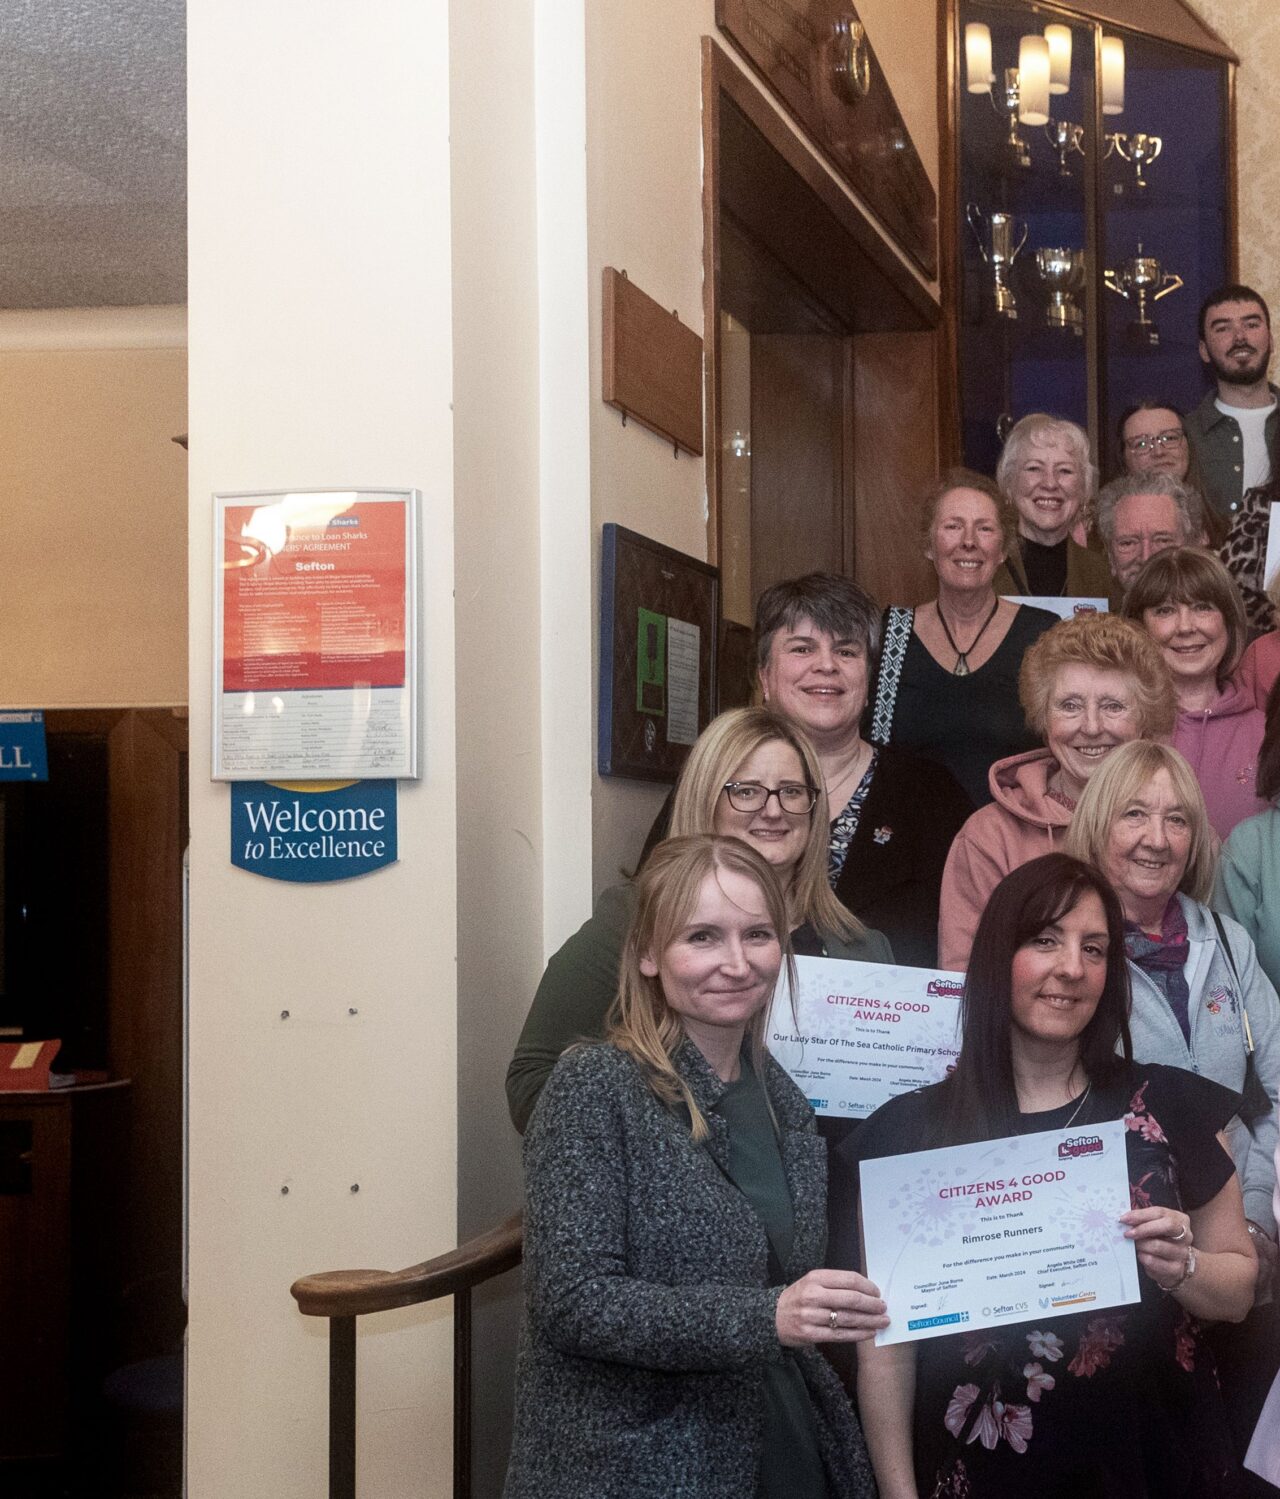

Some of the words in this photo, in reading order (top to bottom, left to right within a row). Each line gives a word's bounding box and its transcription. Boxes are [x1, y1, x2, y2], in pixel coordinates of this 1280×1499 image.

[332, 518, 358, 526] Sharks
[342, 532, 368, 540] Sharks
[304, 543, 351, 551] AGREEMENT
[296, 562, 335, 572] Sefton
[243, 800, 385, 833] Welcome
[244, 840, 264, 859] to
[268, 835, 385, 859] Excellence
[935, 980, 962, 989] Sefton
[827, 995, 880, 1008] CITIZENS
[883, 1001, 891, 1010] 4
[895, 1002, 930, 1013] GOOD
[854, 1010, 900, 1023] AWARD
[790, 1035, 809, 1044] Lady
[811, 1037, 827, 1045] Star
[830, 1038, 839, 1046] Of
[841, 1039, 855, 1048] The
[856, 1041, 870, 1049] Sea
[872, 1042, 904, 1052] Catholic
[906, 1046, 936, 1056] Primary
[937, 1048, 961, 1057] Schoo
[1066, 1136, 1098, 1147] Sefton
[939, 1180, 1005, 1199] CITIZENS
[1009, 1178, 1018, 1188] 4
[1022, 1170, 1066, 1185] GOOD
[975, 1190, 1032, 1208] AWARD
[962, 1232, 1001, 1244] Rimrose
[1004, 1226, 1043, 1237] Runners
[964, 1257, 993, 1265] difference
[1043, 1244, 1075, 1253] community
[1051, 1294, 1077, 1302] Volunteer
[993, 1305, 1013, 1314] Sefton
[1015, 1302, 1028, 1310] CVS
